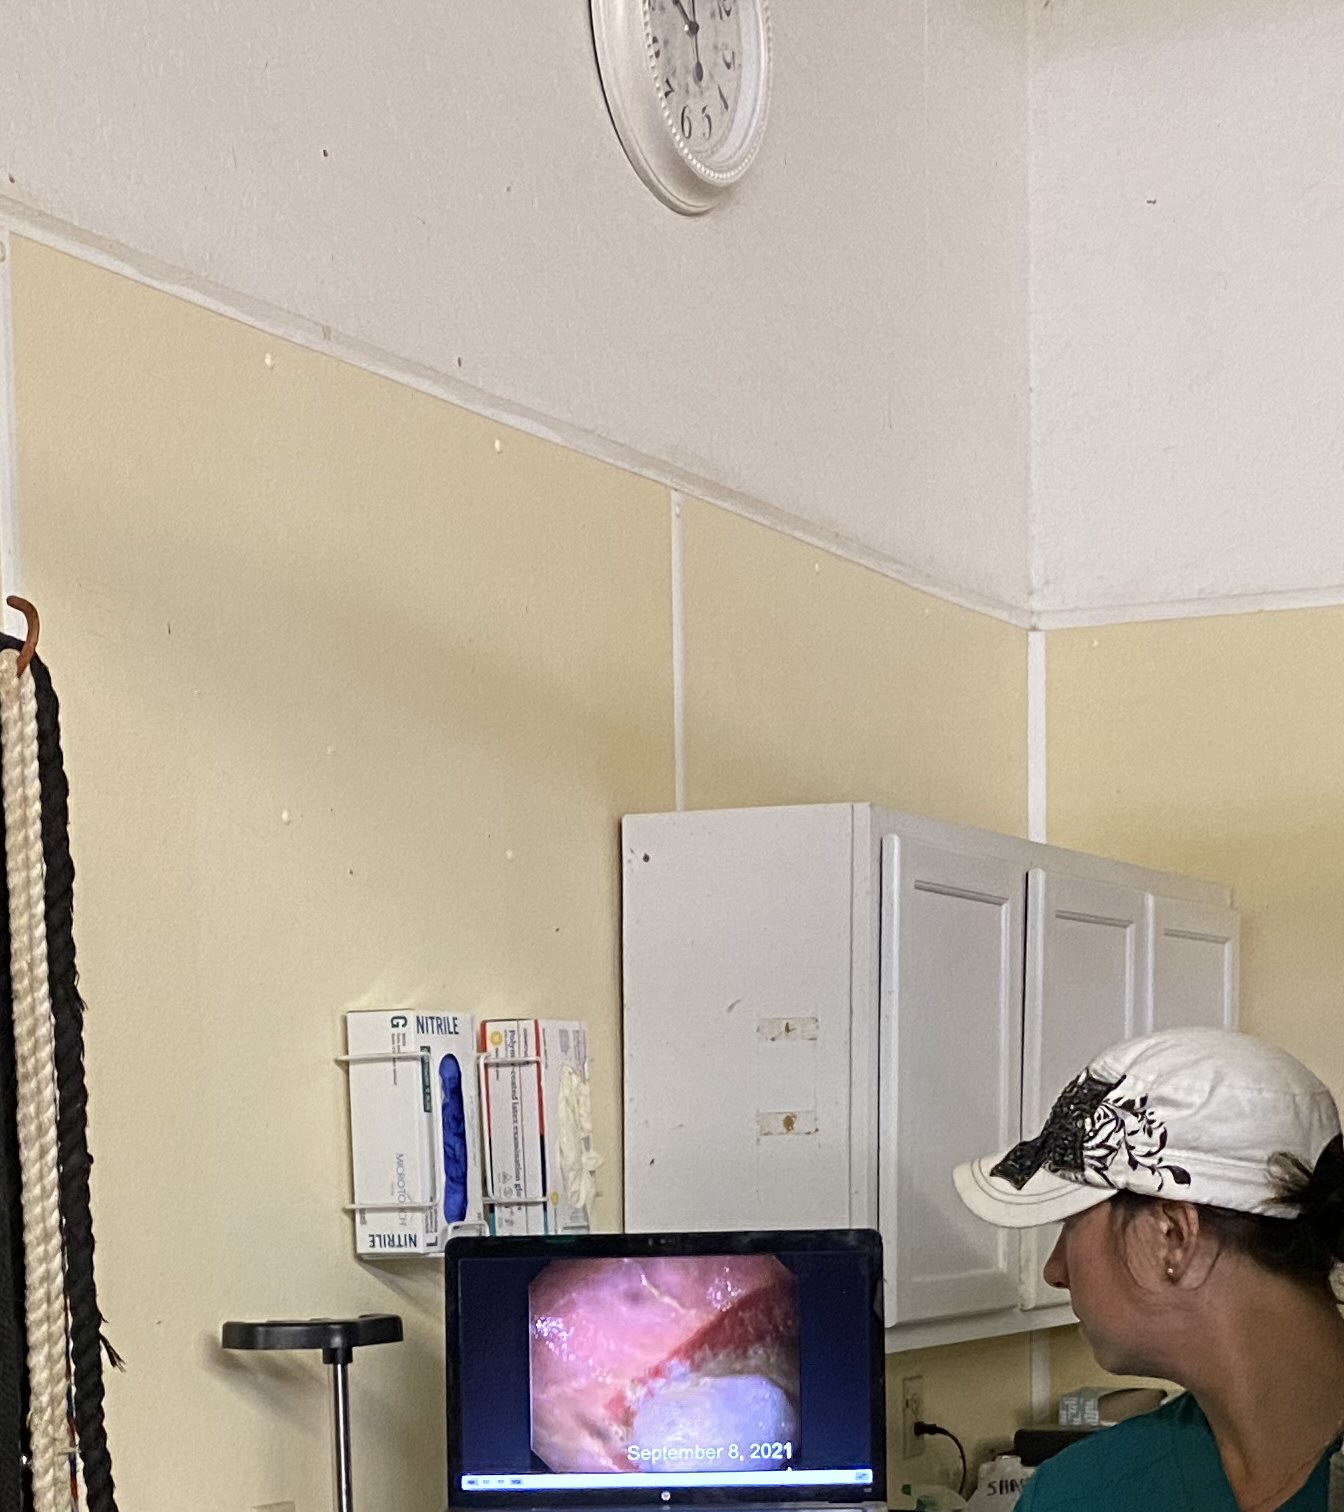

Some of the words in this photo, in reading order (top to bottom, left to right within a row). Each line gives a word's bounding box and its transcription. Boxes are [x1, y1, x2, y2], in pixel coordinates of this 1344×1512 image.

[416, 1015, 459, 1035] NITRILE
[395, 1153, 408, 1227] MICROTOCH
[369, 1233, 418, 1248] NITRILE
[627, 1444, 721, 1464] September
[728, 1444, 744, 1461] 8,
[750, 1442, 792, 1460] 2021
